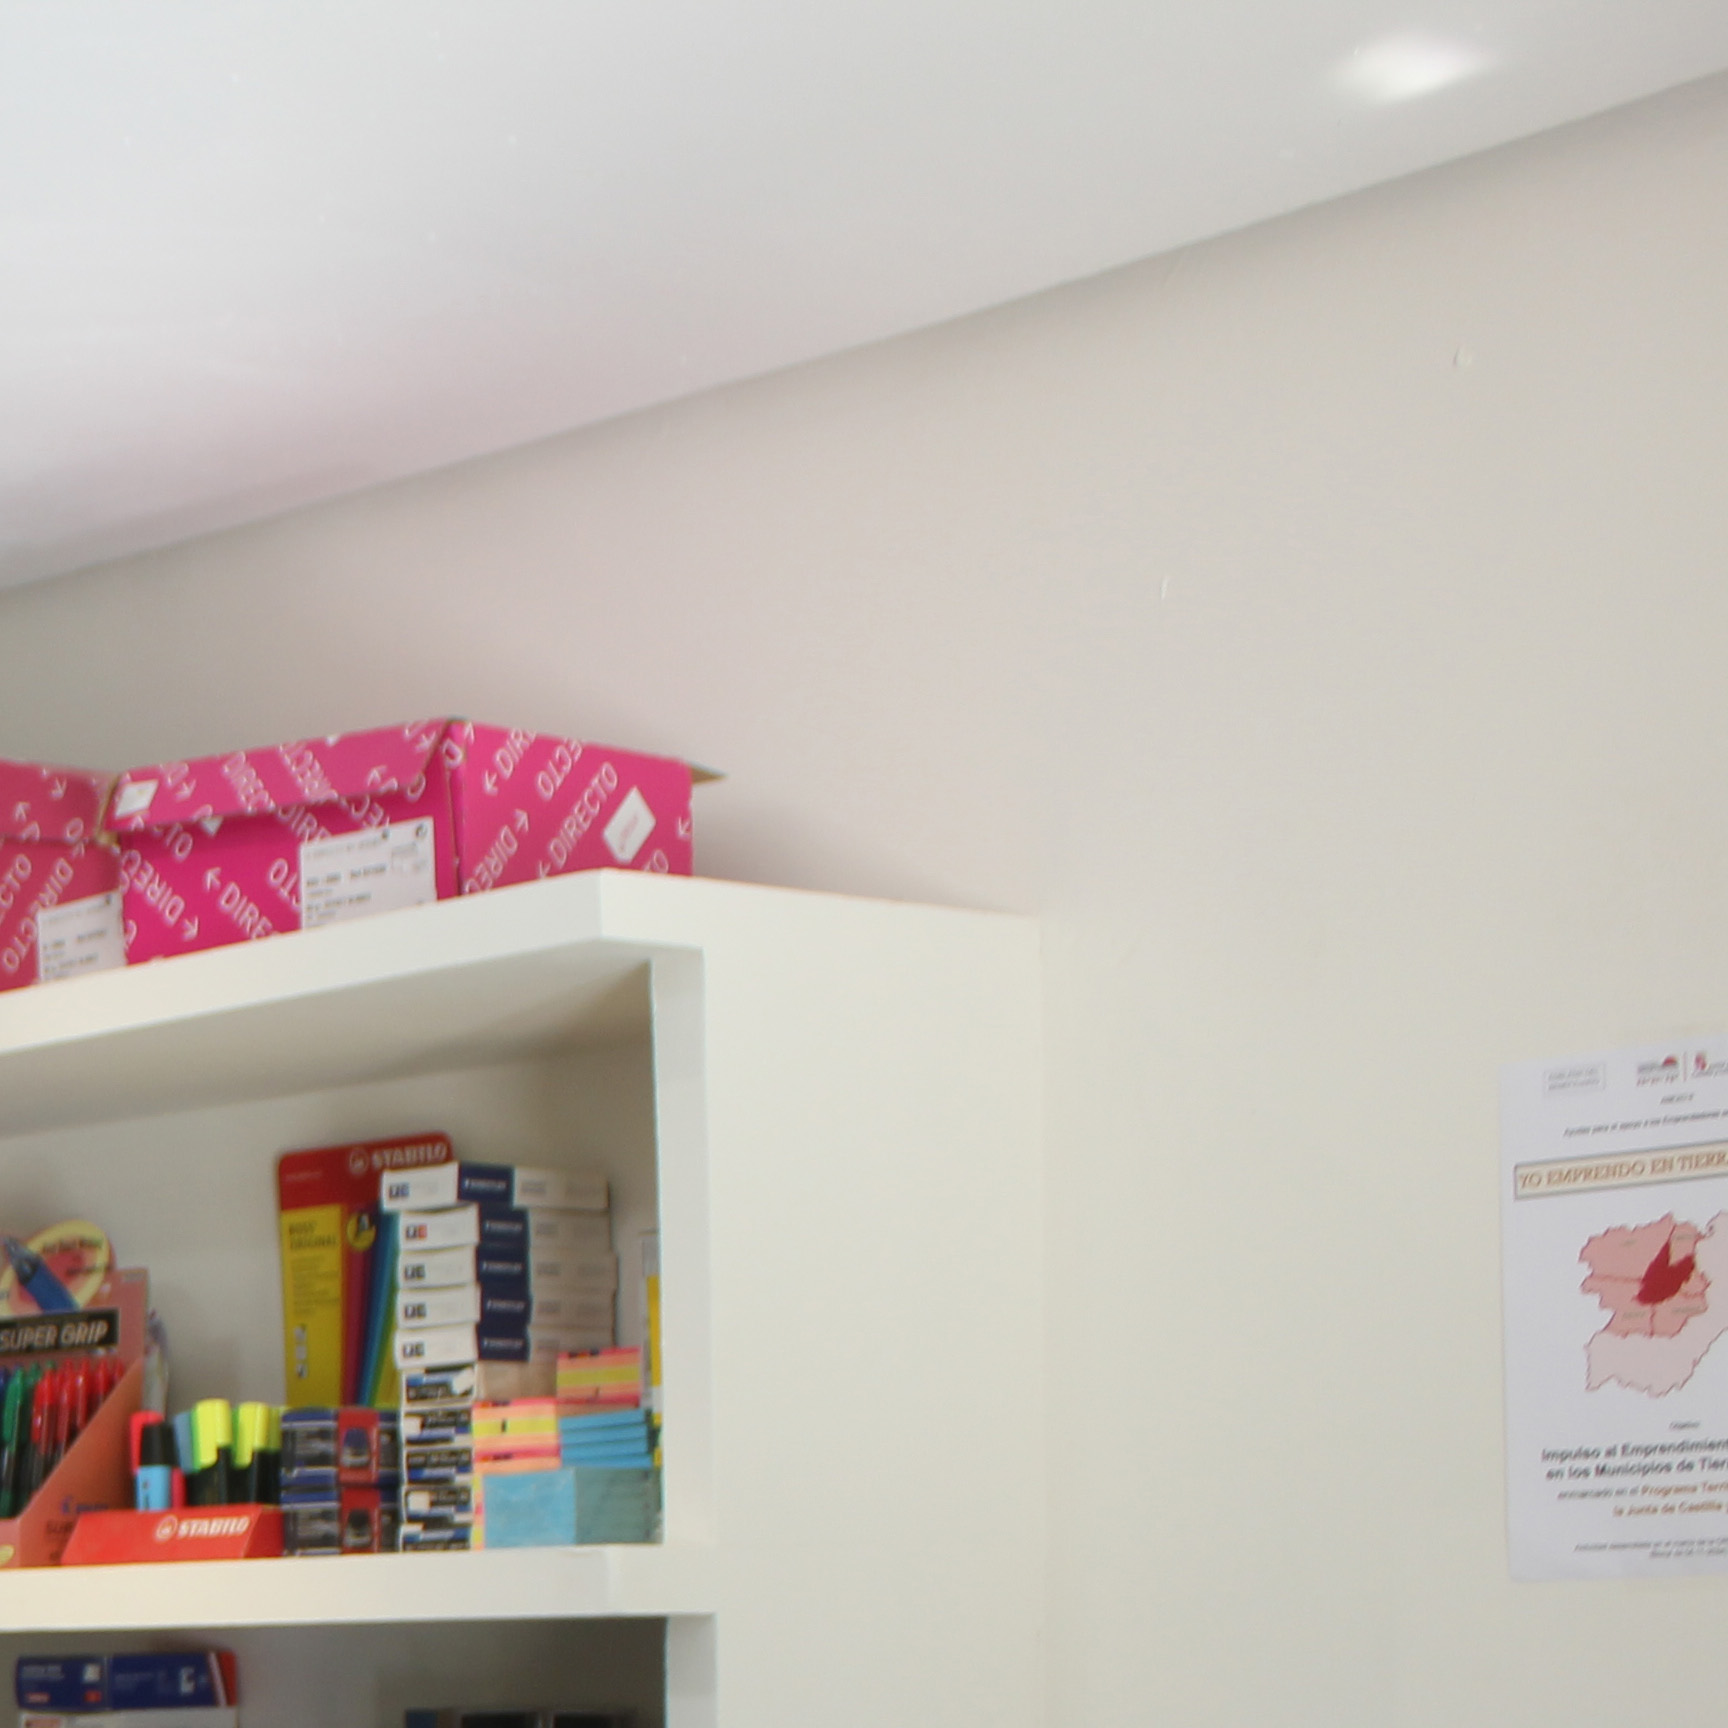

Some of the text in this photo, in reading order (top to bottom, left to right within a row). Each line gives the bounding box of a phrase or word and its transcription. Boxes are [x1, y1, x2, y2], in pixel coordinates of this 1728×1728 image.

[549, 762, 619, 869] DIRECTO
[371, 1142, 447, 1169] STABILO
[1518, 1151, 1728, 1189] YO EMPRENDO EN TIERR
[60, 1319, 110, 1345] GRIP
[1541, 1448, 1602, 1463] Impulso
[1604, 1444, 1617, 1459] al
[1546, 1467, 1564, 1481] en
[1568, 1466, 1591, 1480] los
[1594, 1461, 1673, 1478] Municipios
[1676, 1458, 1694, 1473] de
[1641, 1483, 1698, 1498] Programa
[176, 1516, 250, 1539] STABILO
